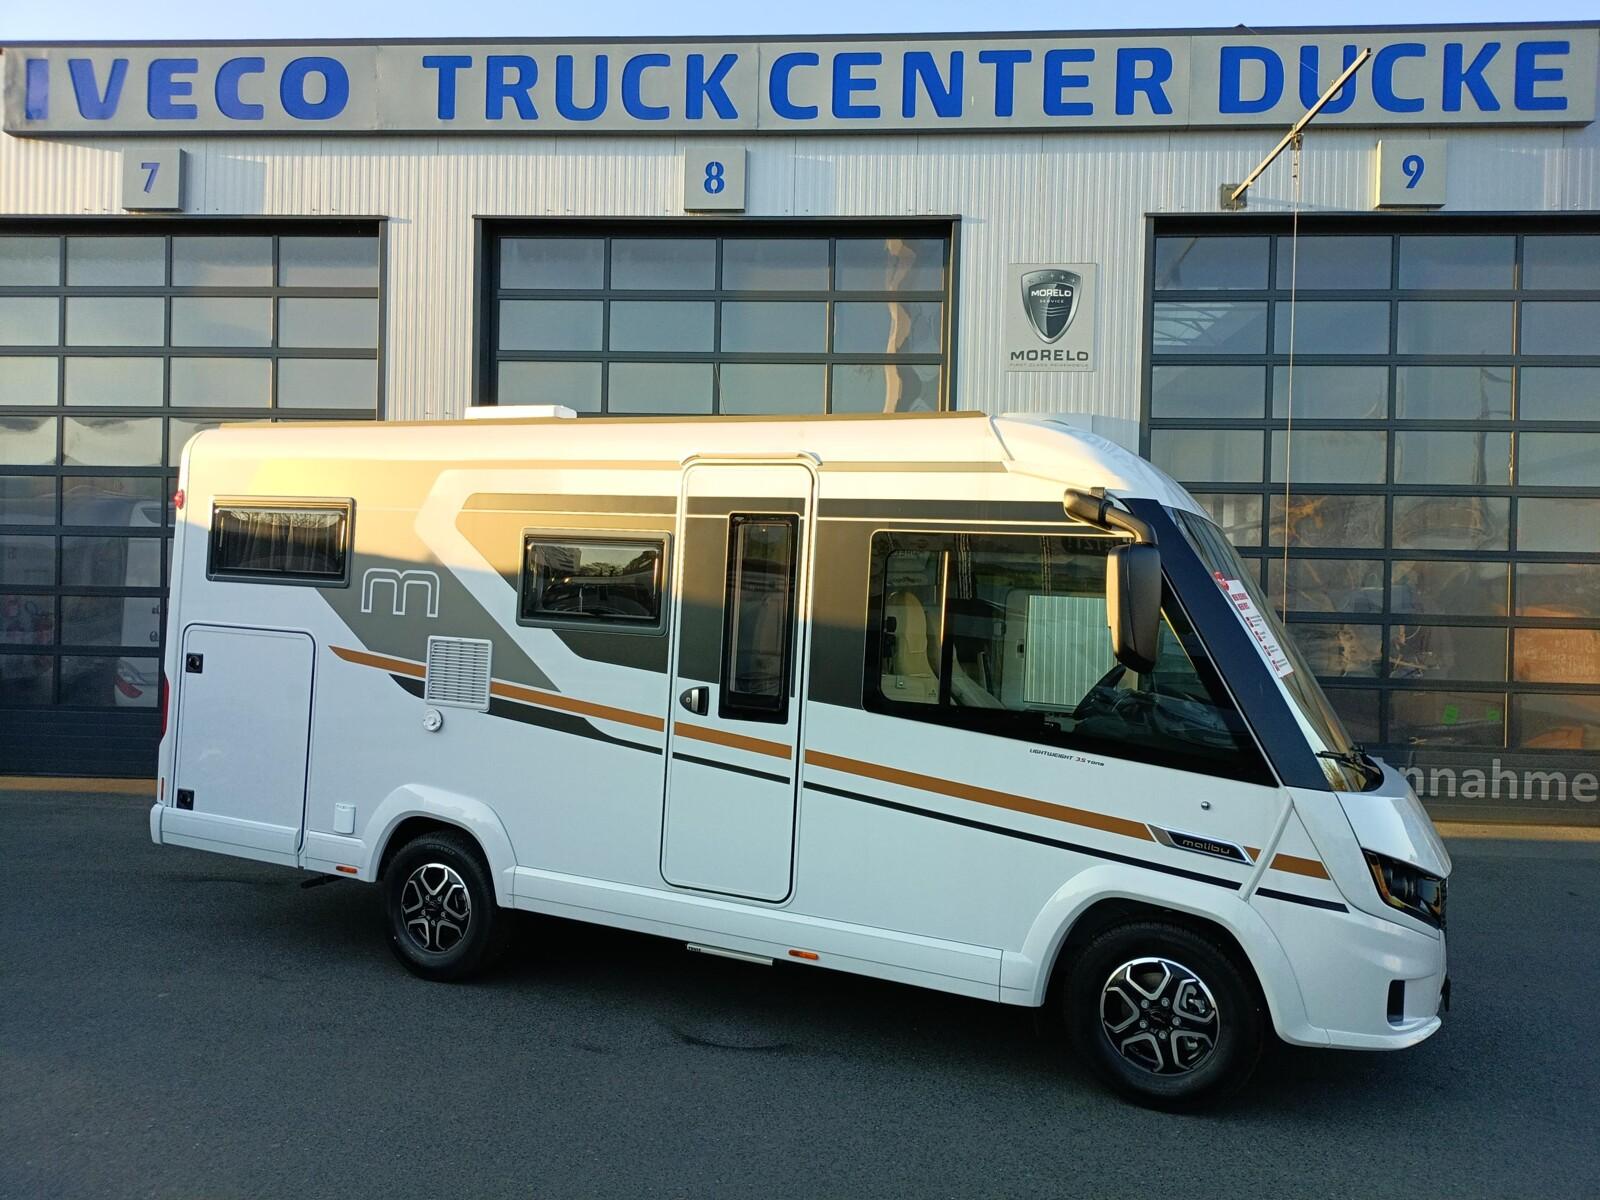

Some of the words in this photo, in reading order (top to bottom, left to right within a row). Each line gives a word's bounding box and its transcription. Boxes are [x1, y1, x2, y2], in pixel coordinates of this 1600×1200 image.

[25, 56, 350, 121] IVECO
[421, 53, 741, 121] TRUCK
[768, 47, 1174, 121] CENTER
[1218, 40, 1573, 115] DUCKE
[140, 161, 161, 194] 7
[703, 160, 726, 195] 8
[1401, 153, 1426, 190] 9
[1031, 288, 1072, 297] MORELO
[1010, 349, 1089, 361] MORELO
[1182, 839, 1230, 855] malibu
